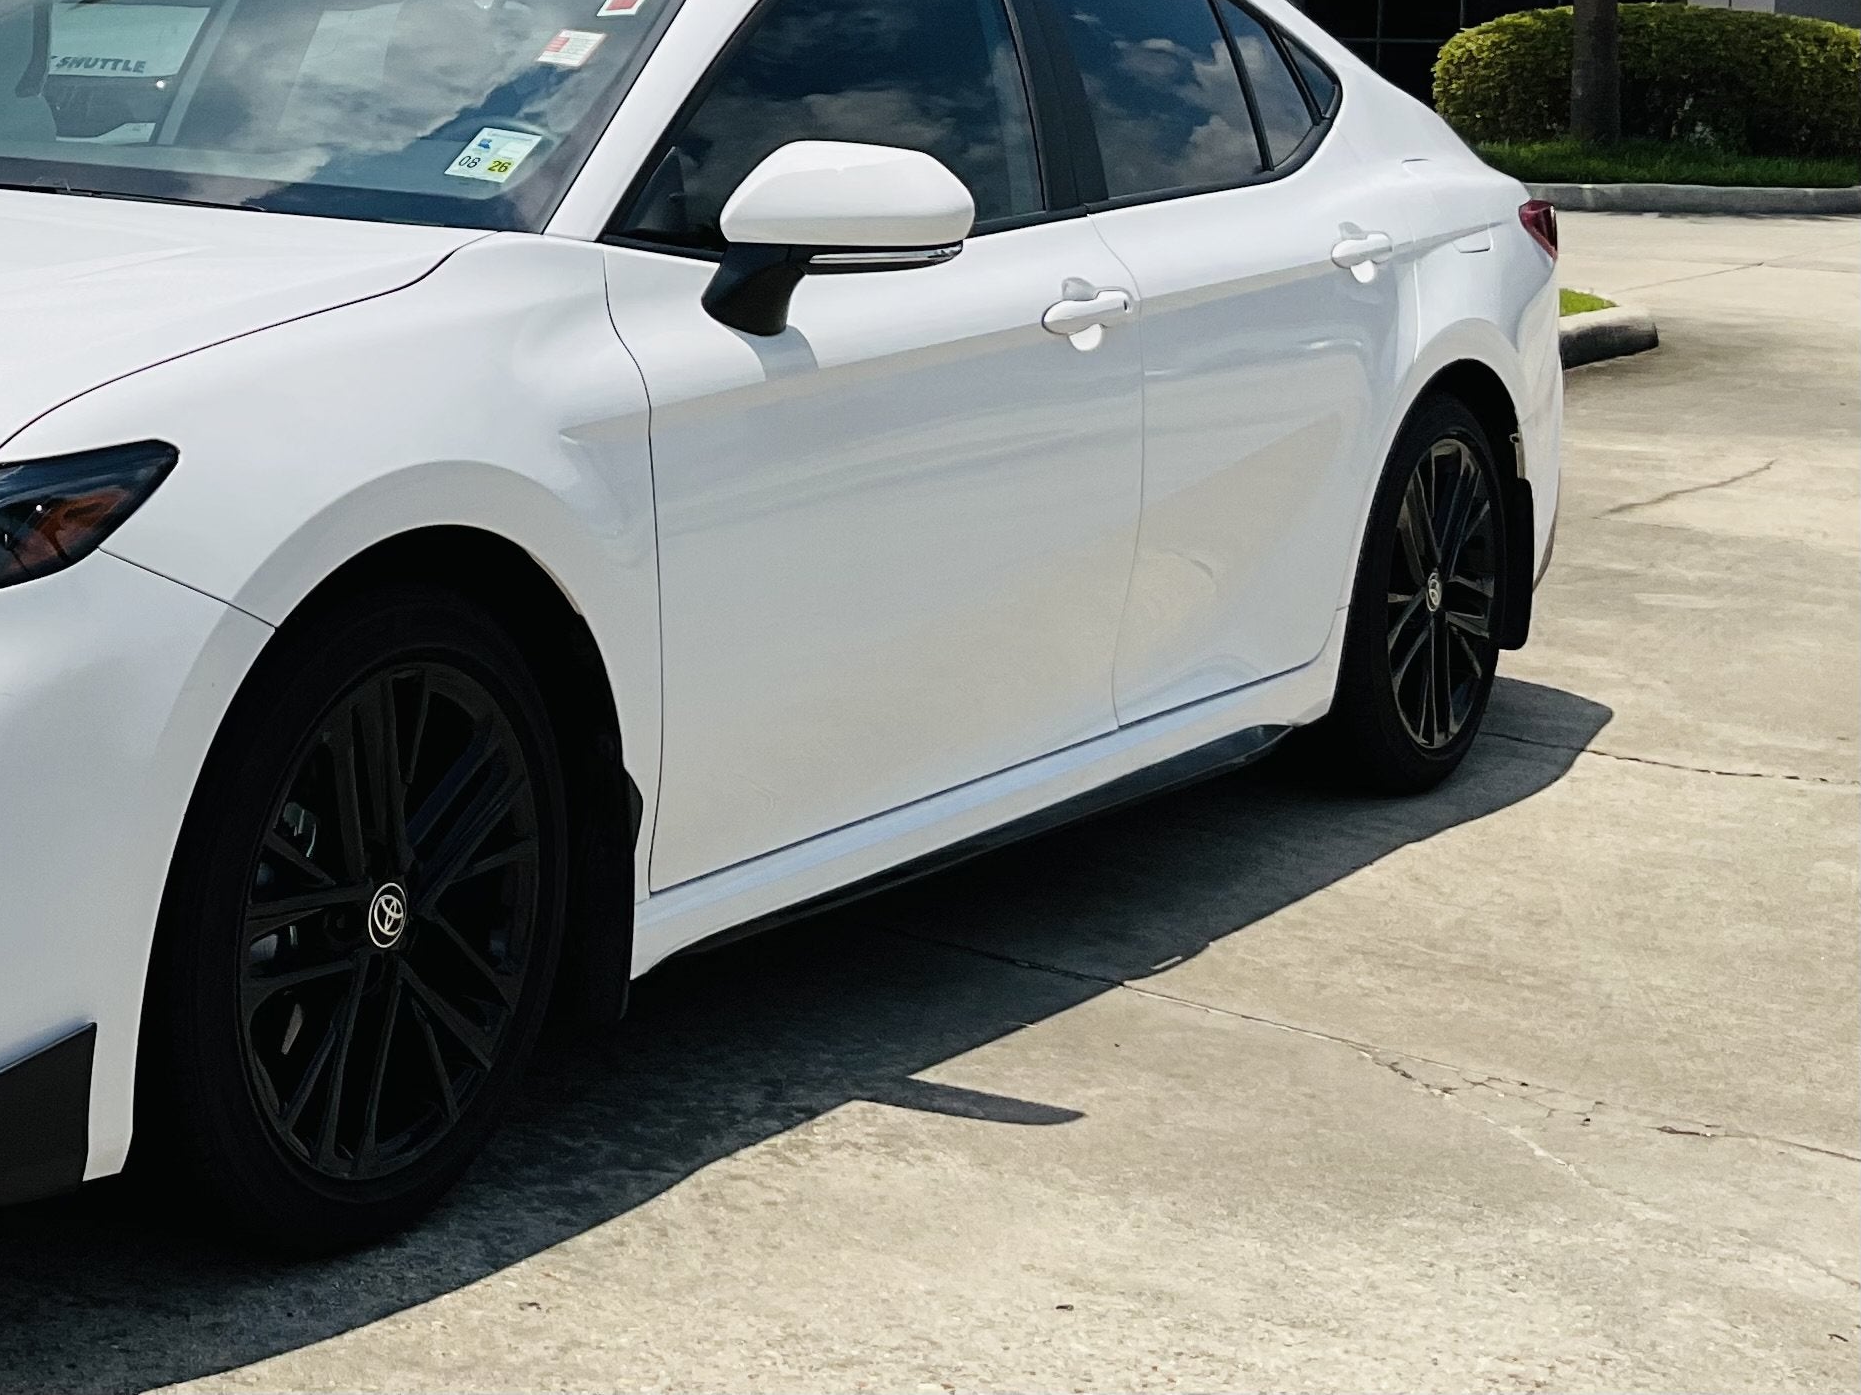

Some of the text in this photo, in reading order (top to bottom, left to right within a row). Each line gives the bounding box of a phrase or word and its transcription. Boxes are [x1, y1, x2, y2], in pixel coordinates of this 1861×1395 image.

[56, 56, 146, 73] SHUTTLE
[458, 155, 481, 169] 08
[487, 160, 512, 173] 26
